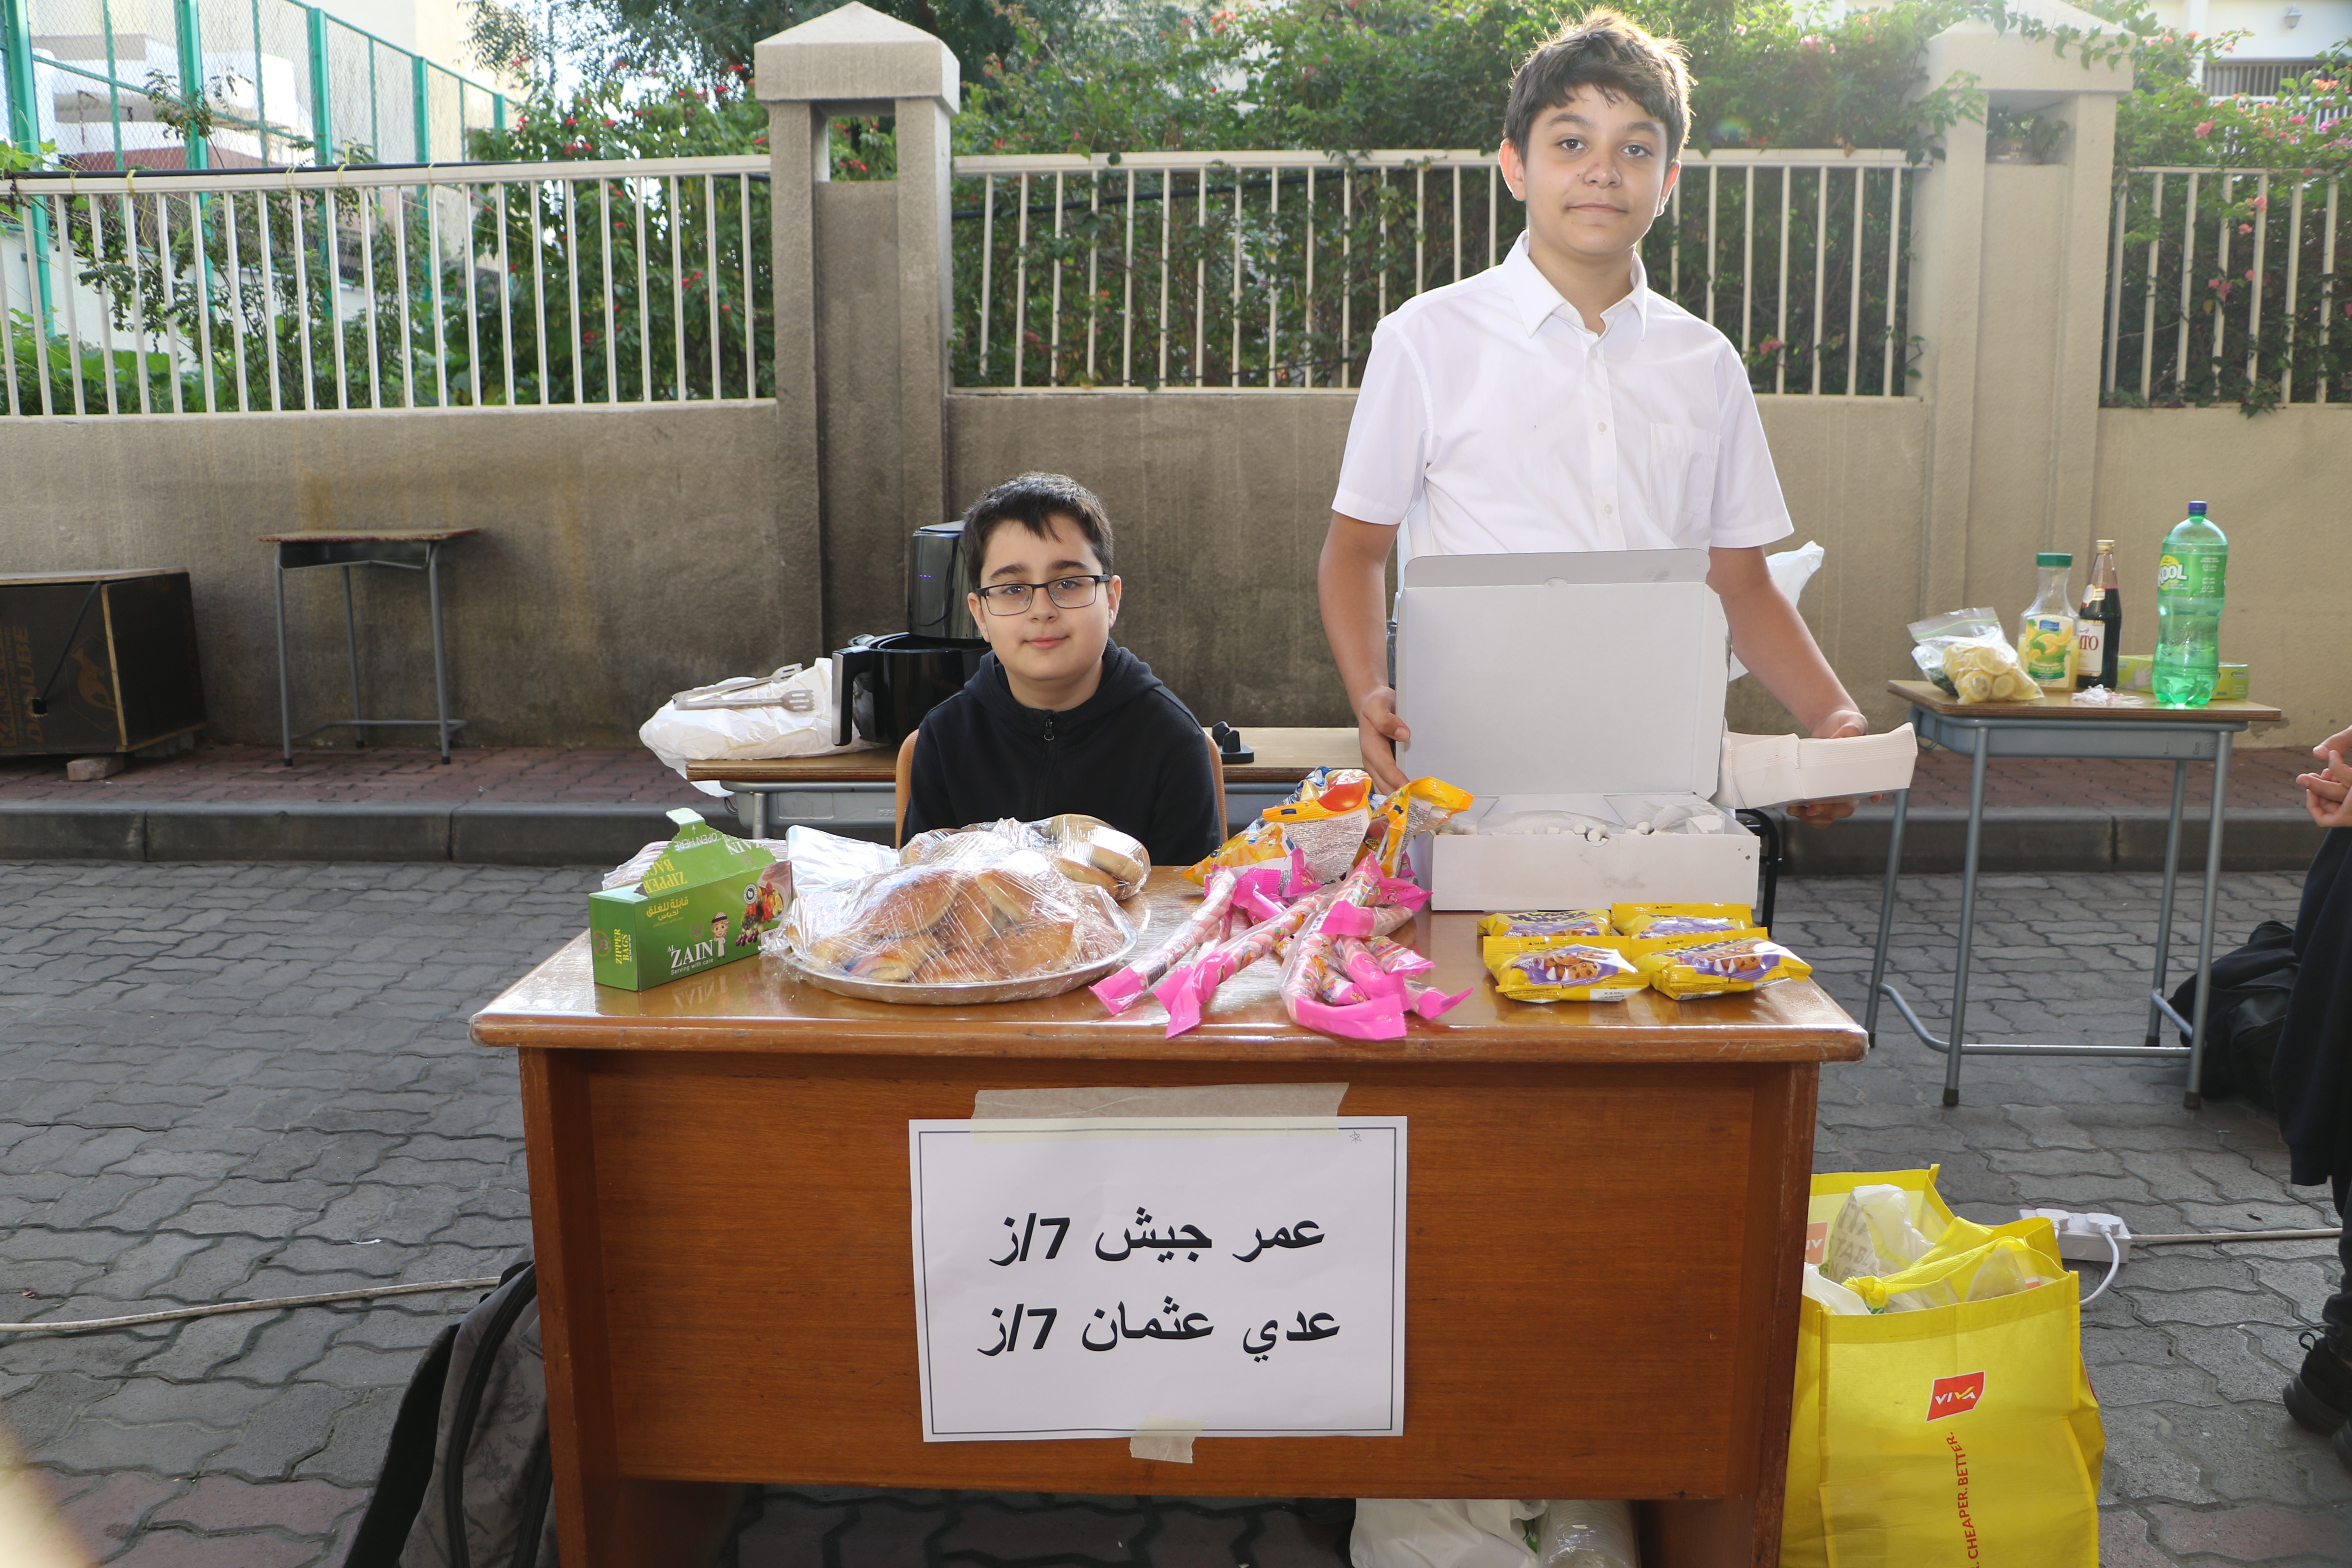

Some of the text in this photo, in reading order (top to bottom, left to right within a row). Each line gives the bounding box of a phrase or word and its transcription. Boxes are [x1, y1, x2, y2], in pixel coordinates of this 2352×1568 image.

[674, 833, 717, 851] OPEN HERE
[643, 871, 687, 894] ZIPPER
[671, 896, 689, 909] قابلة
[614, 929, 622, 965] ZIPPER
[671, 939, 714, 969] ZAIN
[671, 965, 690, 975] Serving
[1095, 1207, 1212, 1263] جيش
[1233, 1220, 1325, 1262] عمر
[1082, 1296, 1214, 1352] عثمان
[1243, 1311, 1340, 1363] عدي
[1935, 1386, 1976, 1405] VIVA
[1946, 1432, 1979, 1559] CHEAPER. BETTER.
